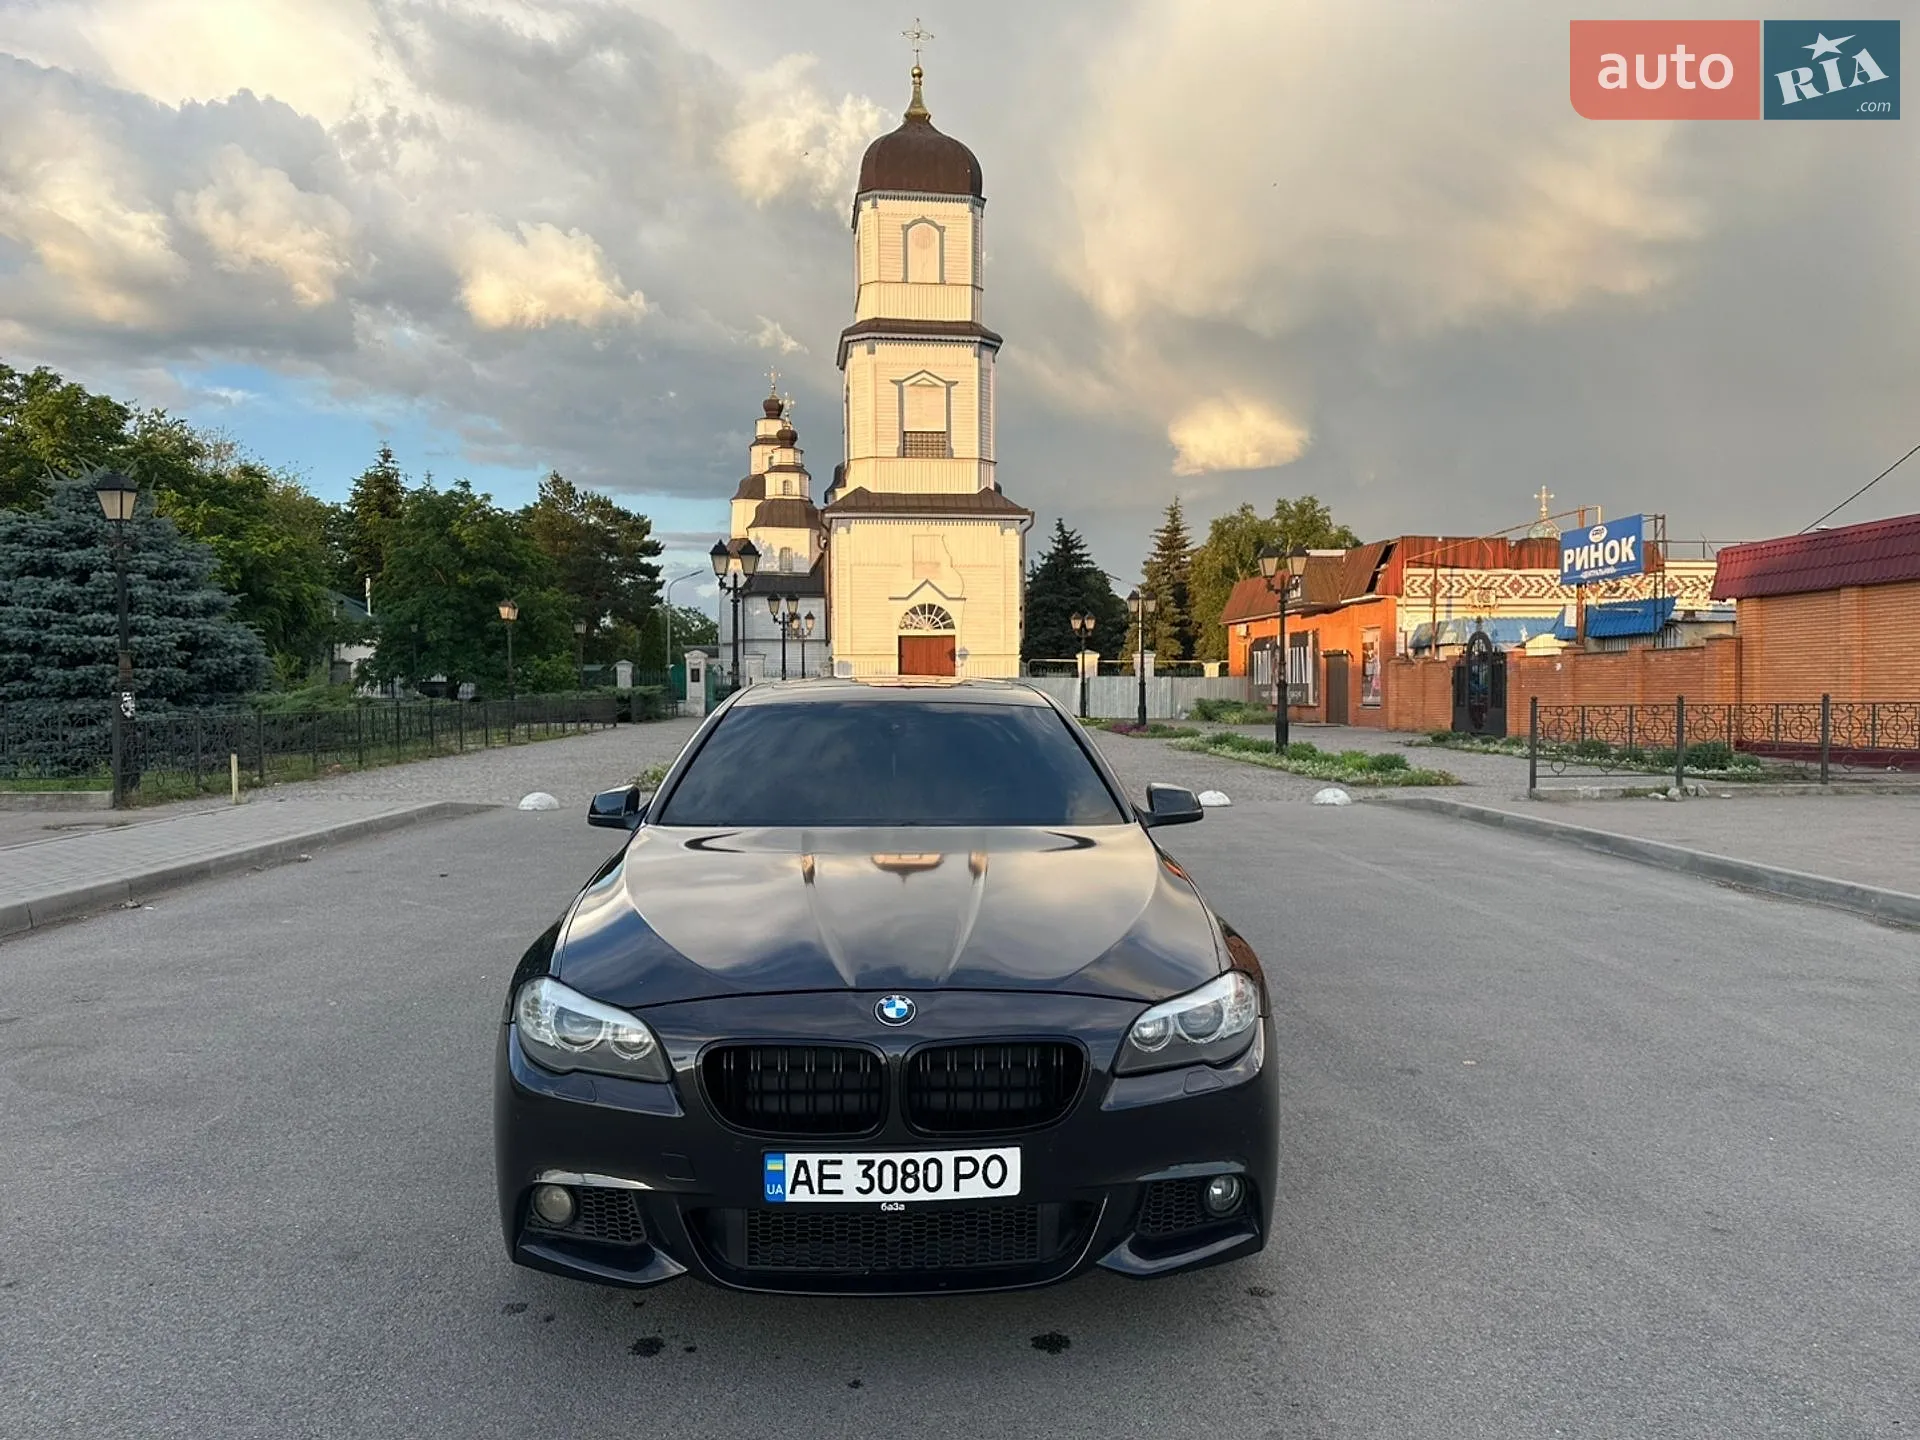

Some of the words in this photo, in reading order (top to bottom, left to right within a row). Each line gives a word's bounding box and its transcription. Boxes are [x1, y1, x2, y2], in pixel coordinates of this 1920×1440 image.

[1563, 535, 1636, 573] РИНОК
[766, 1184, 784, 1195] UA
[789, 1158, 844, 1195] AE
[855, 1157, 943, 1195] 3080
[953, 1153, 1008, 1192] PO
